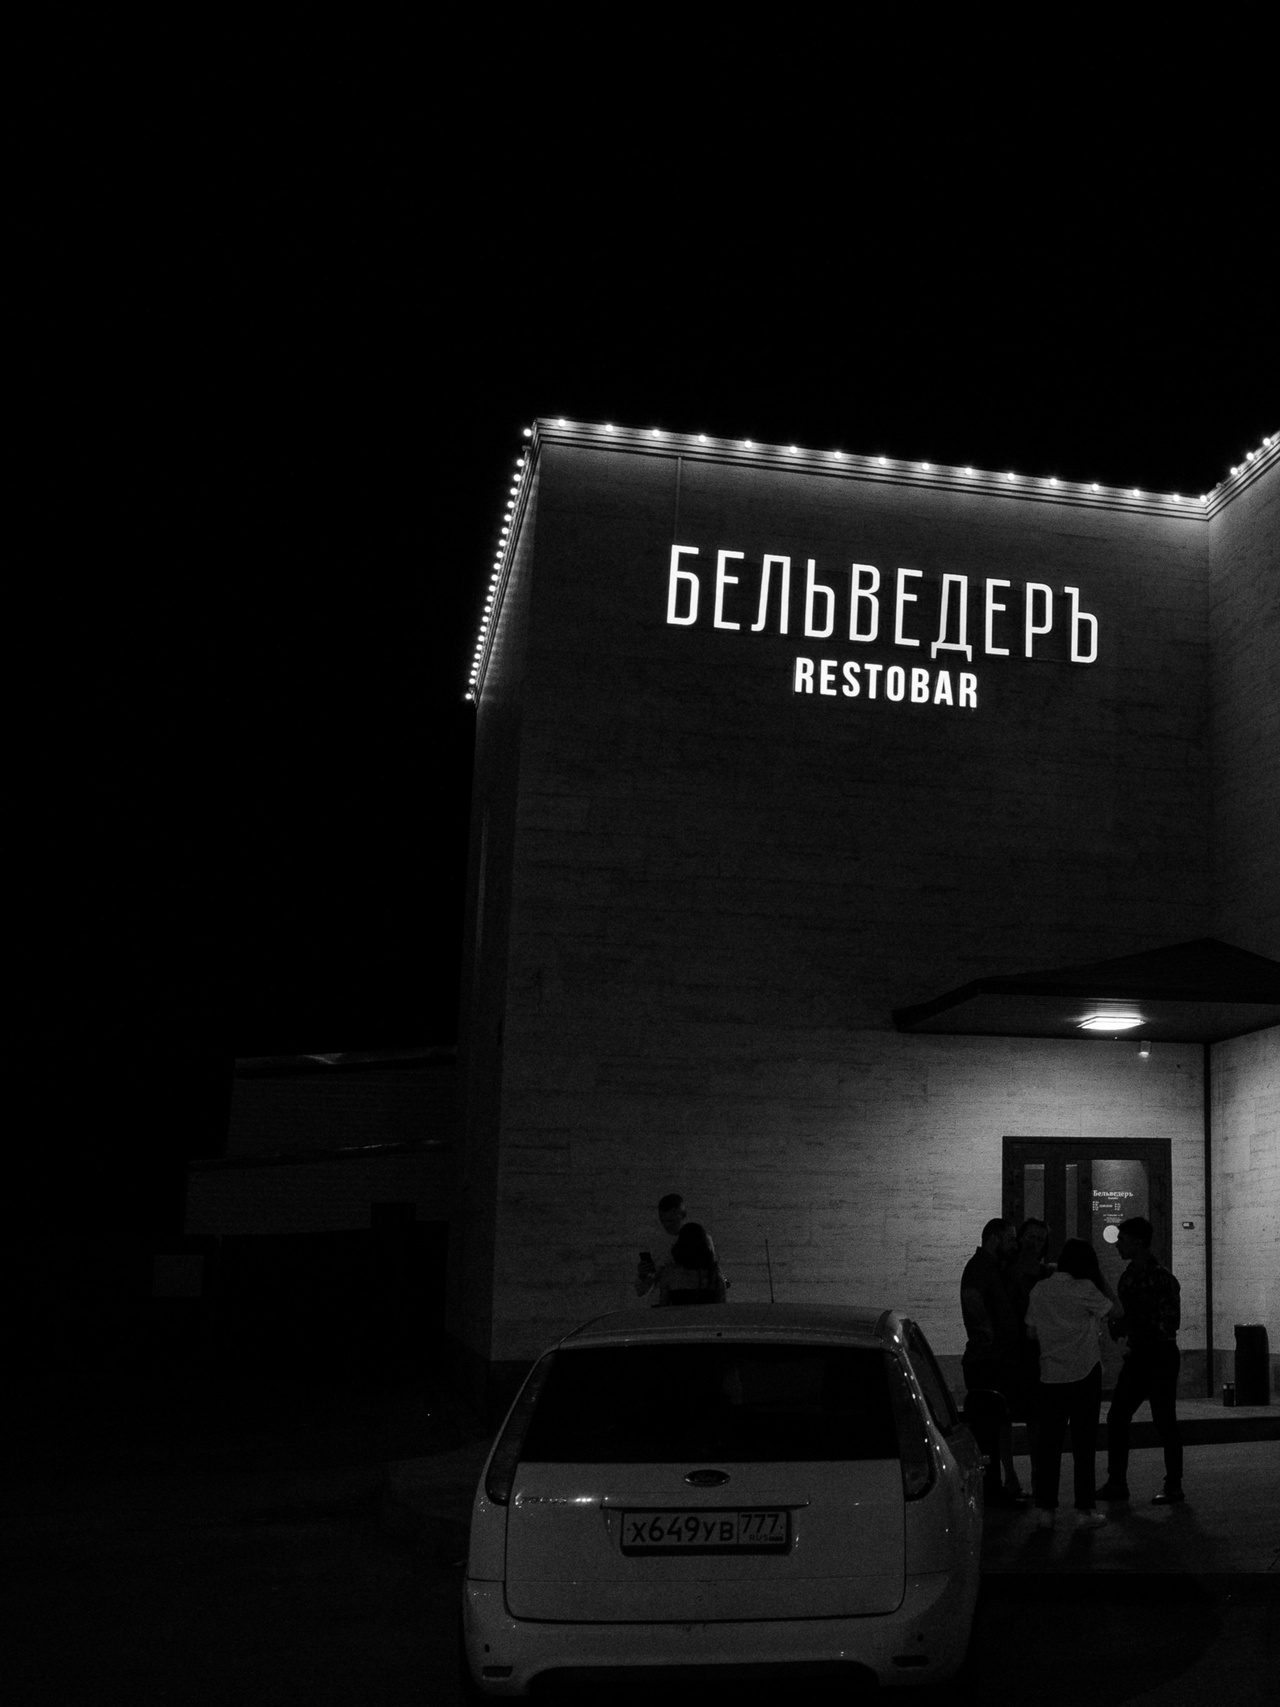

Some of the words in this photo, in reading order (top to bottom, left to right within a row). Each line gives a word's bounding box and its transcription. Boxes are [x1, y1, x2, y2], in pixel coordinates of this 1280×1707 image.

[666, 544, 1098, 664] БЕЛЬВЕДЕРЪ
[793, 657, 978, 708] RESTOBAR
[741, 1514, 780, 1534] 777
